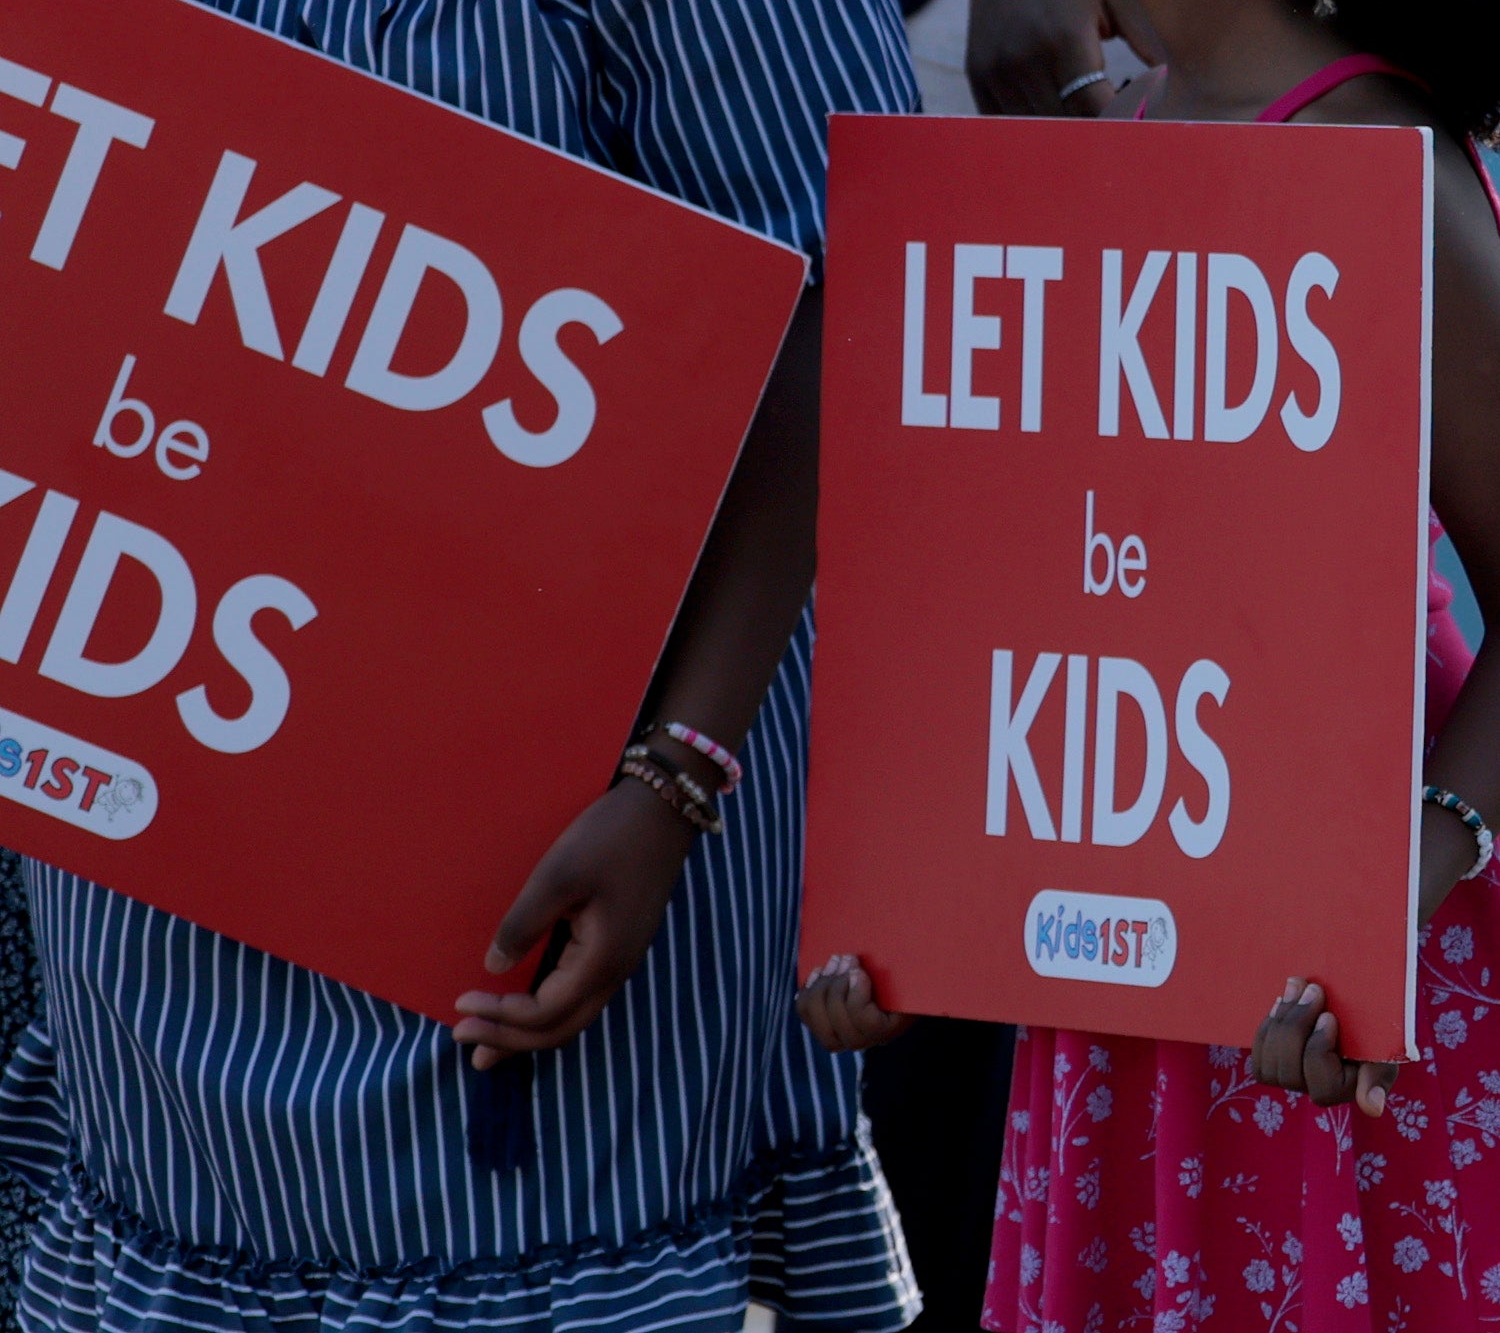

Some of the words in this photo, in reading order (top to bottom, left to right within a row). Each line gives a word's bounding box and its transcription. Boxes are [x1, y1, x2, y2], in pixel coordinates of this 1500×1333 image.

[163, 149, 624, 468] KIDS
[902, 242, 1063, 432] LET
[1099, 249, 1341, 452] KIDS
[93, 354, 209, 480] be
[0, 468, 319, 754] IDS
[1084, 490, 1147, 598] be
[986, 649, 1230, 858] KIDS
[1035, 904, 1148, 968] Kids1ST
